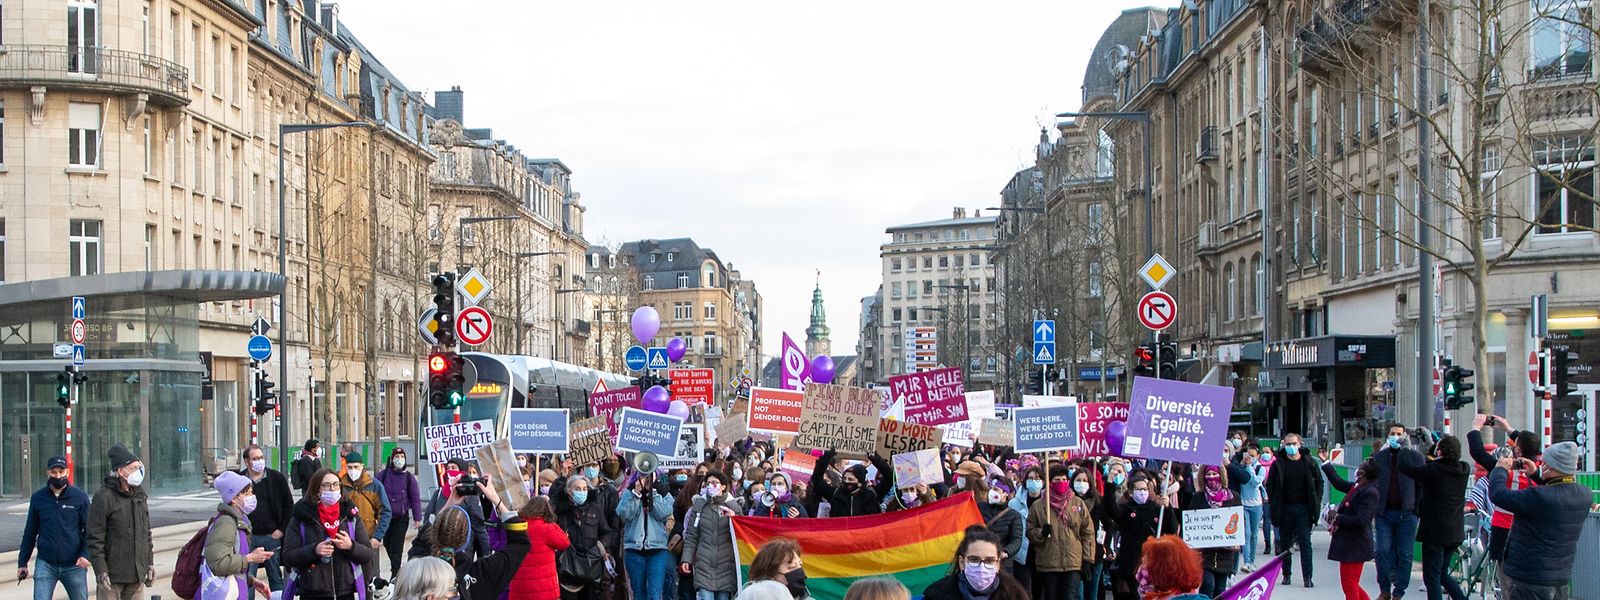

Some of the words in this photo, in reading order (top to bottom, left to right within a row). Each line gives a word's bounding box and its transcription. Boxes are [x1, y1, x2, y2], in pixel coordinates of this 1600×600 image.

[616, 392, 636, 403] TOUCH
[755, 398, 802, 408] PROFITEROLES
[806, 398, 842, 414] LESBO
[845, 401, 873, 416] QUEER
[946, 402, 964, 418] SIN
[1146, 395, 1214, 418] Diversité.
[754, 414, 781, 422] GENDER
[814, 413, 836, 421] contre
[1150, 414, 1204, 434] Egalité.
[426, 423, 468, 440] EGALITE
[627, 418, 652, 428] BINARY
[661, 424, 676, 432] OUT
[801, 420, 876, 442] CAPITALISME
[880, 419, 898, 433] NO
[902, 423, 935, 442] MORE
[1042, 424, 1068, 432] QUEER.
[1084, 420, 1105, 434] LES
[624, 434, 660, 446] UNICORN!
[642, 428, 656, 436] FOR
[658, 432, 671, 440] THE
[1151, 432, 1190, 451] Unité
